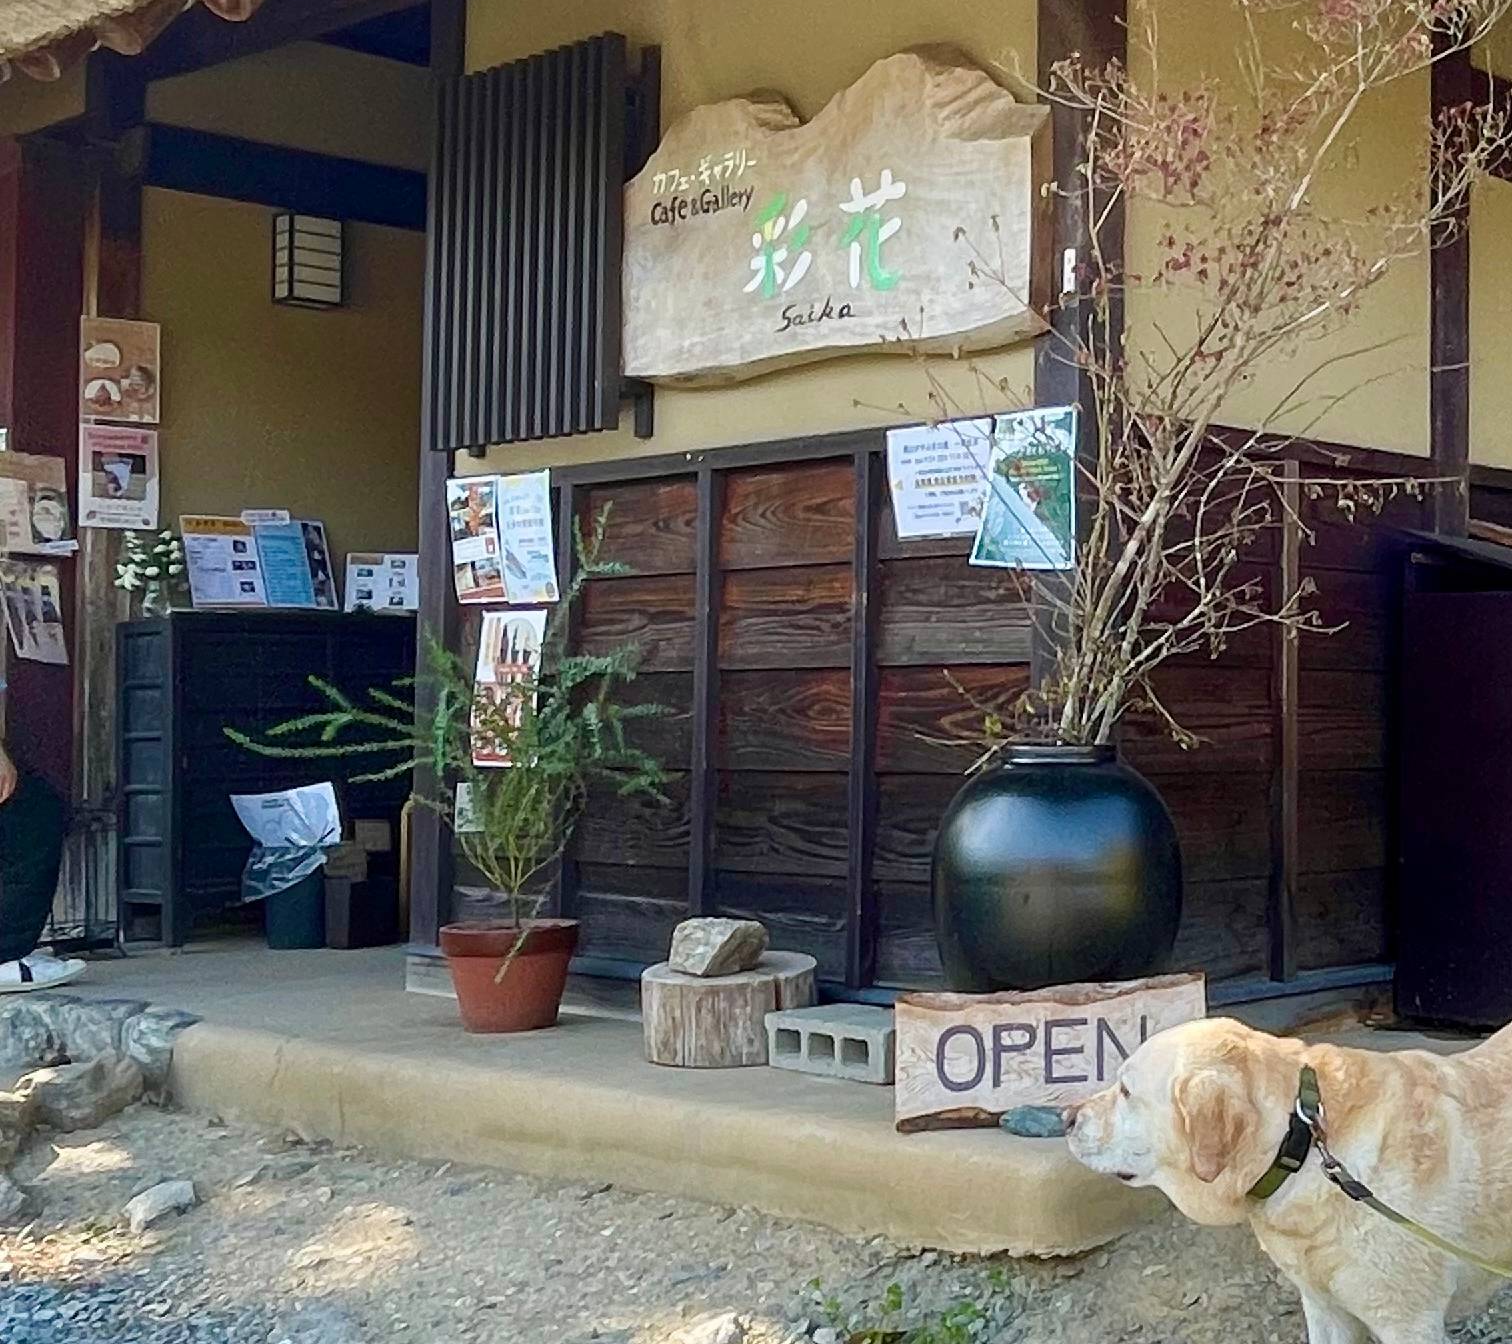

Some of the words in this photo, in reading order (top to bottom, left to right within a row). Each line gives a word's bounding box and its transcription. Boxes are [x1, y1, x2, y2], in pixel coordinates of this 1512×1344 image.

[741, 168, 908, 300] 彩花
[774, 296, 856, 332] Saika
[935, 1014, 1148, 1093] OPEN
